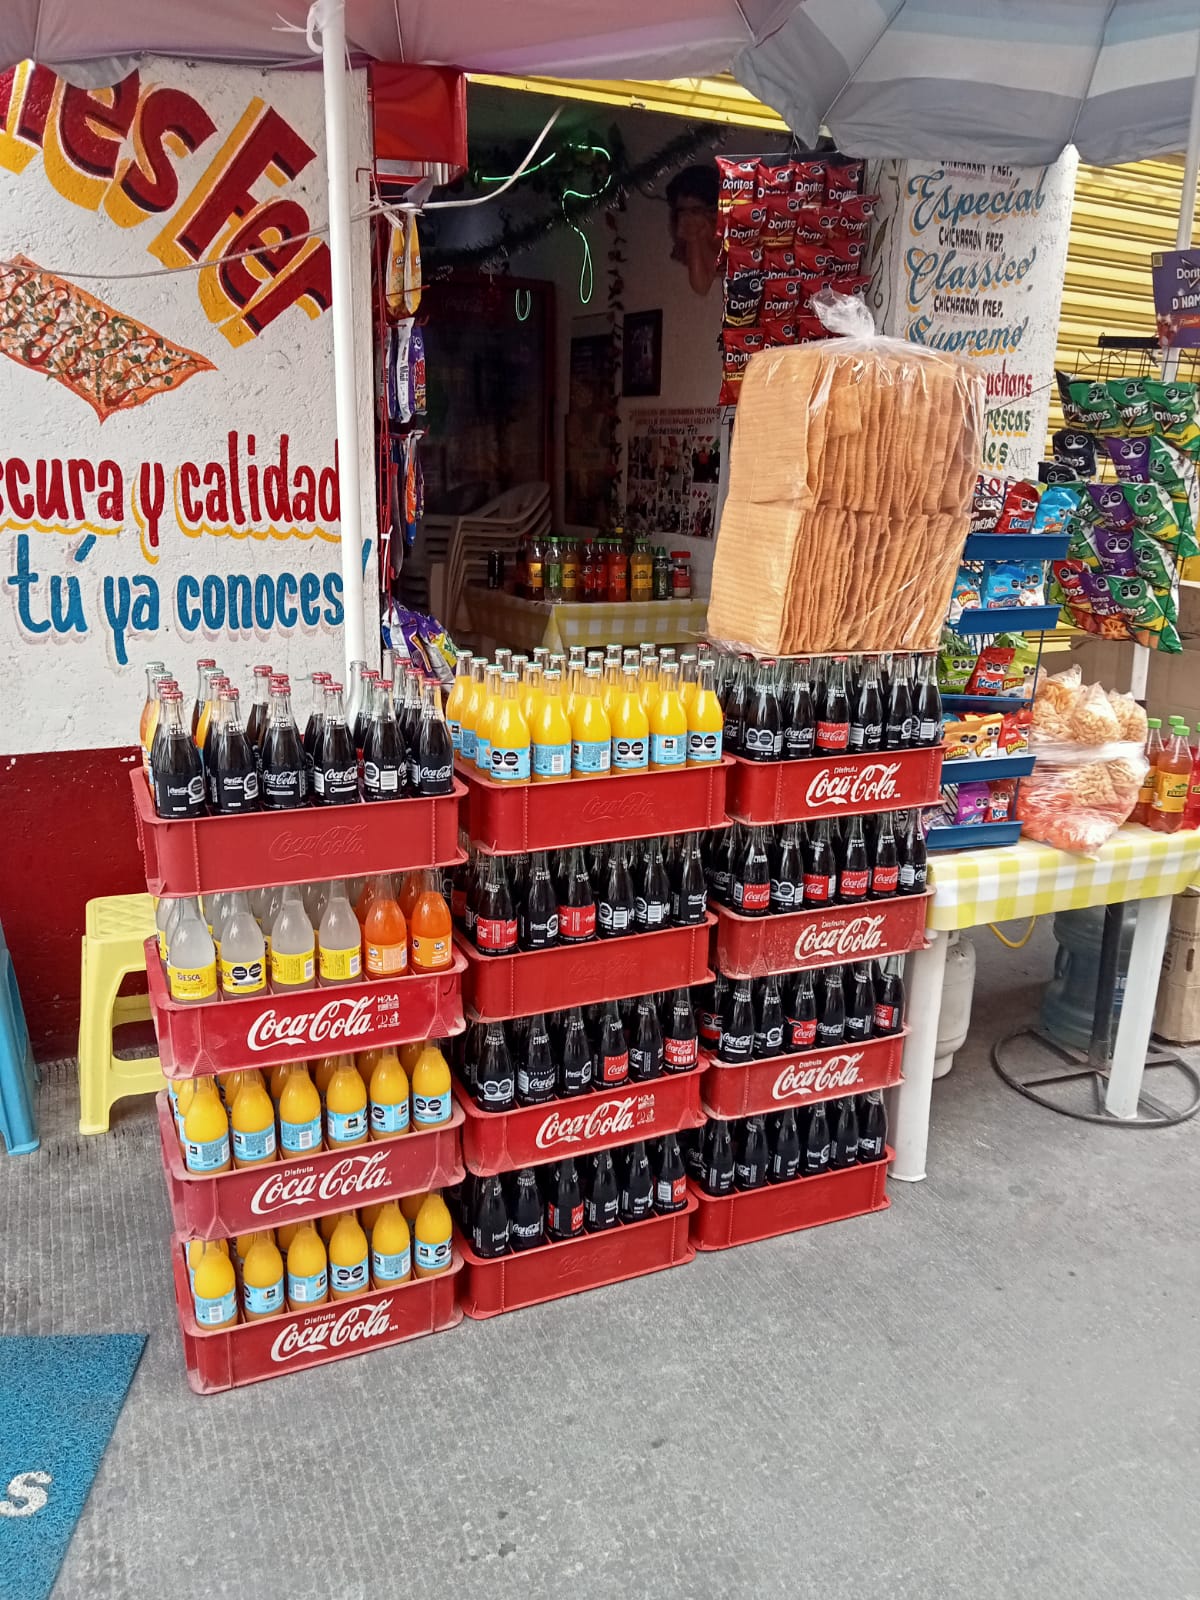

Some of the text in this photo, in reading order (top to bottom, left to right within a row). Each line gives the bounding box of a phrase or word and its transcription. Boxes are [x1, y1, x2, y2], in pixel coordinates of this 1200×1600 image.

[722, 179, 754, 190] Doritos
[908, 166, 1049, 231] Especial
[172, 104, 331, 340] Fer
[906, 246, 1036, 305] Classico
[0, 430, 341, 547] cura y calidad
[8, 533, 97, 634] tú
[103, 574, 159, 665] ya
[806, 762, 902, 808] Coca-Cola
[268, 824, 368, 862] Coca-Cola
[794, 914, 887, 961] Coca-Cola
[247, 995, 376, 1051] Coca-Cola
[772, 1051, 865, 1100] Coca-Cola
[535, 1096, 638, 1149] Coca-Cola
[250, 1151, 392, 1215] Coca-Cola
[284, 1164, 314, 1178] Disfruta
[271, 1297, 394, 1362] Coca-Cola
[304, 1312, 336, 1326] Disfruta
